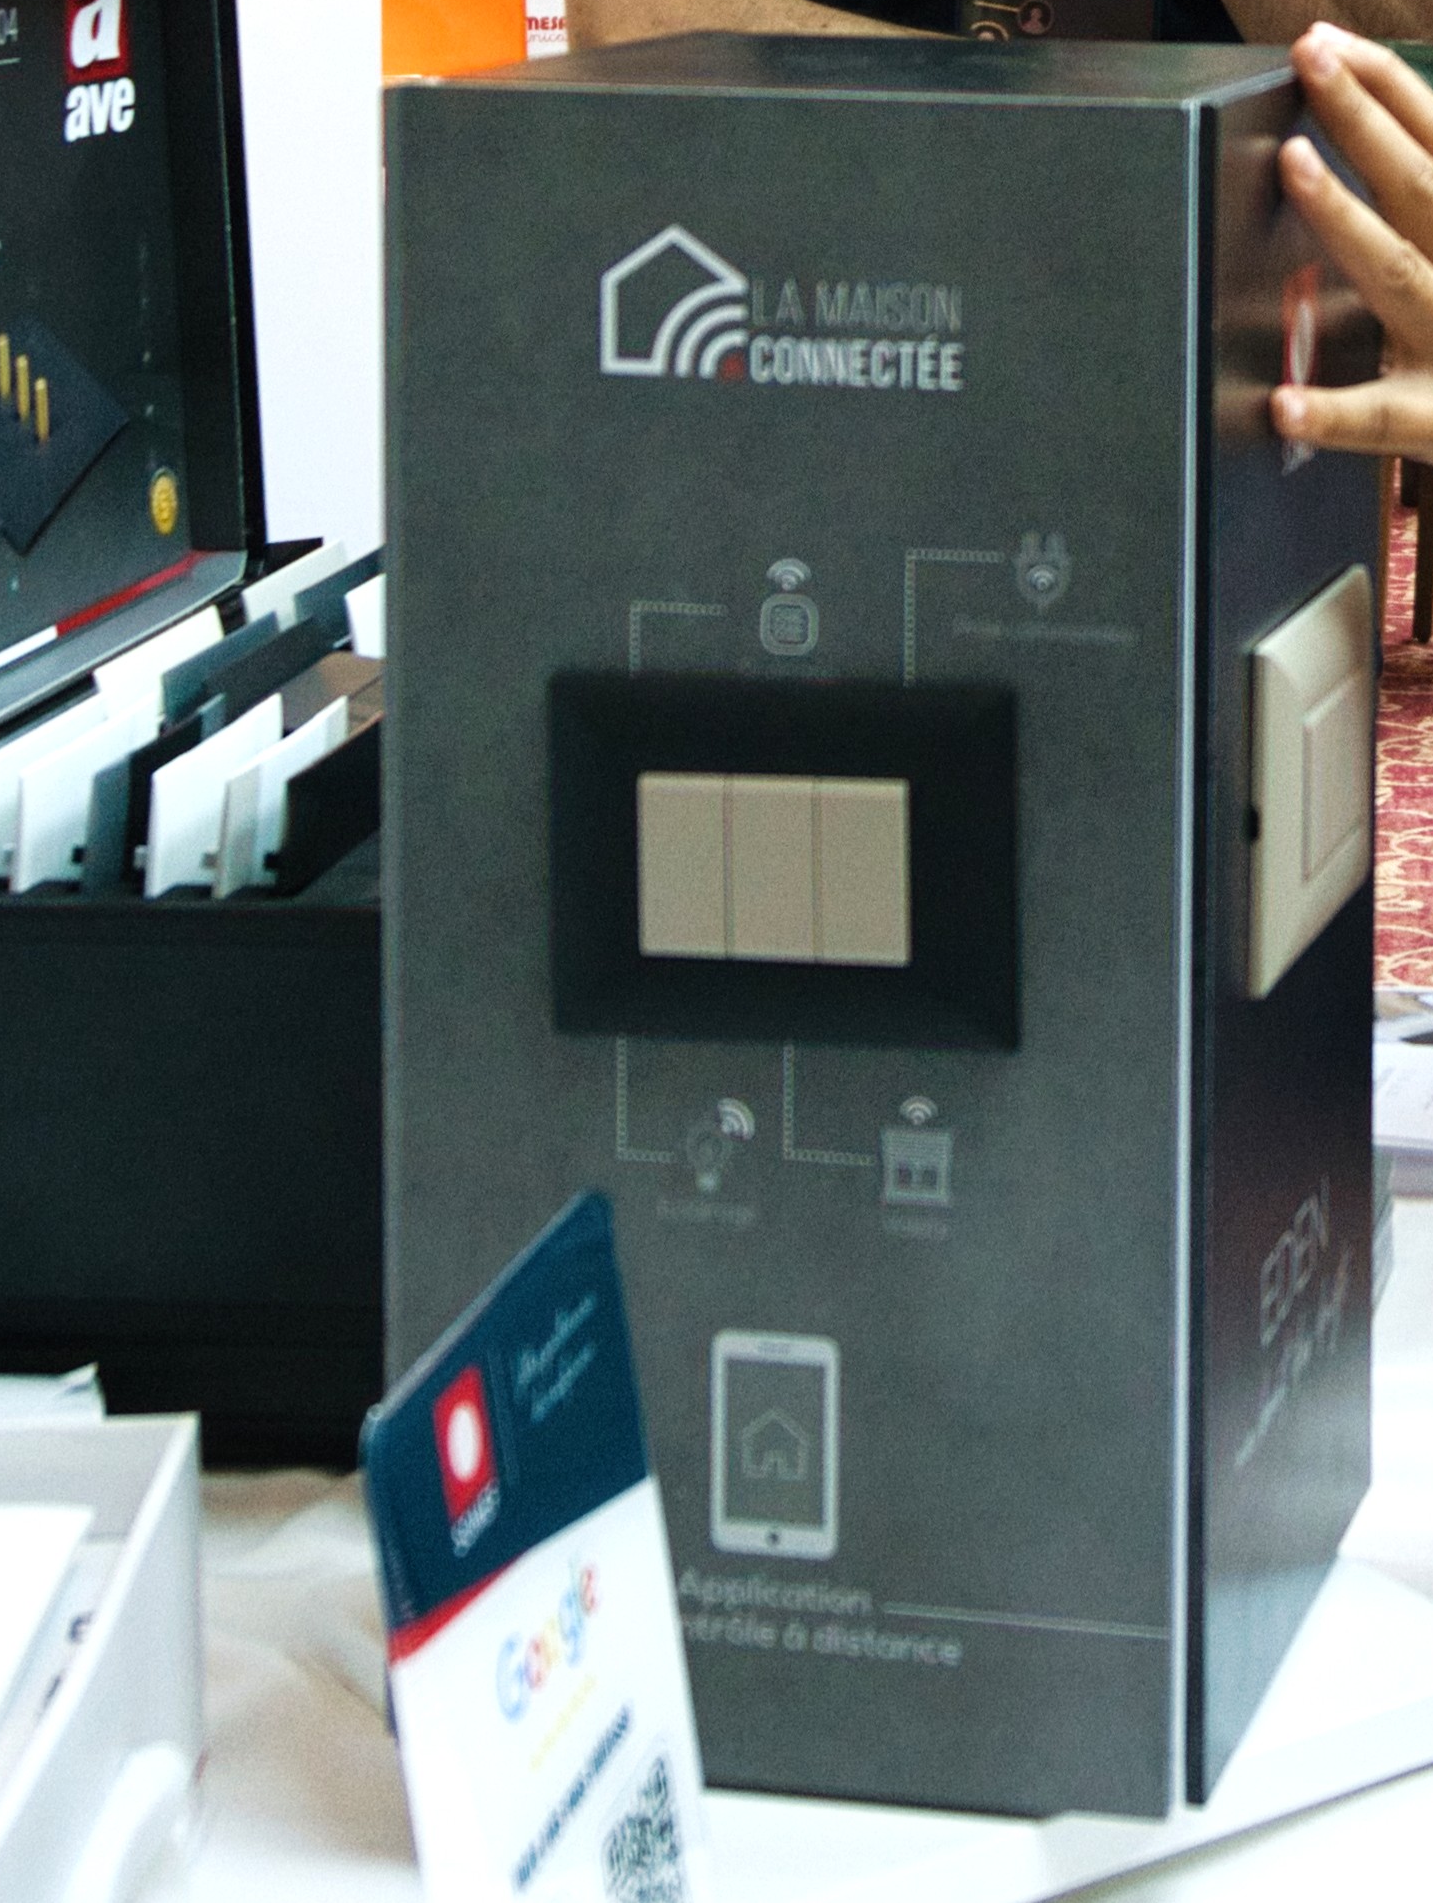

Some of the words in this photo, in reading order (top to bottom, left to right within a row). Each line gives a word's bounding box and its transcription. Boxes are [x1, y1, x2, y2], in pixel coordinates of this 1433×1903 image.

[64, 76, 136, 143] ave
[750, 274, 806, 327] LA
[816, 278, 964, 333] MAISON
[749, 333, 966, 392] CONNECTÉE
[678, 1565, 874, 1617] Application
[496, 1554, 598, 1724] Google
[813, 1622, 964, 1668] distance
